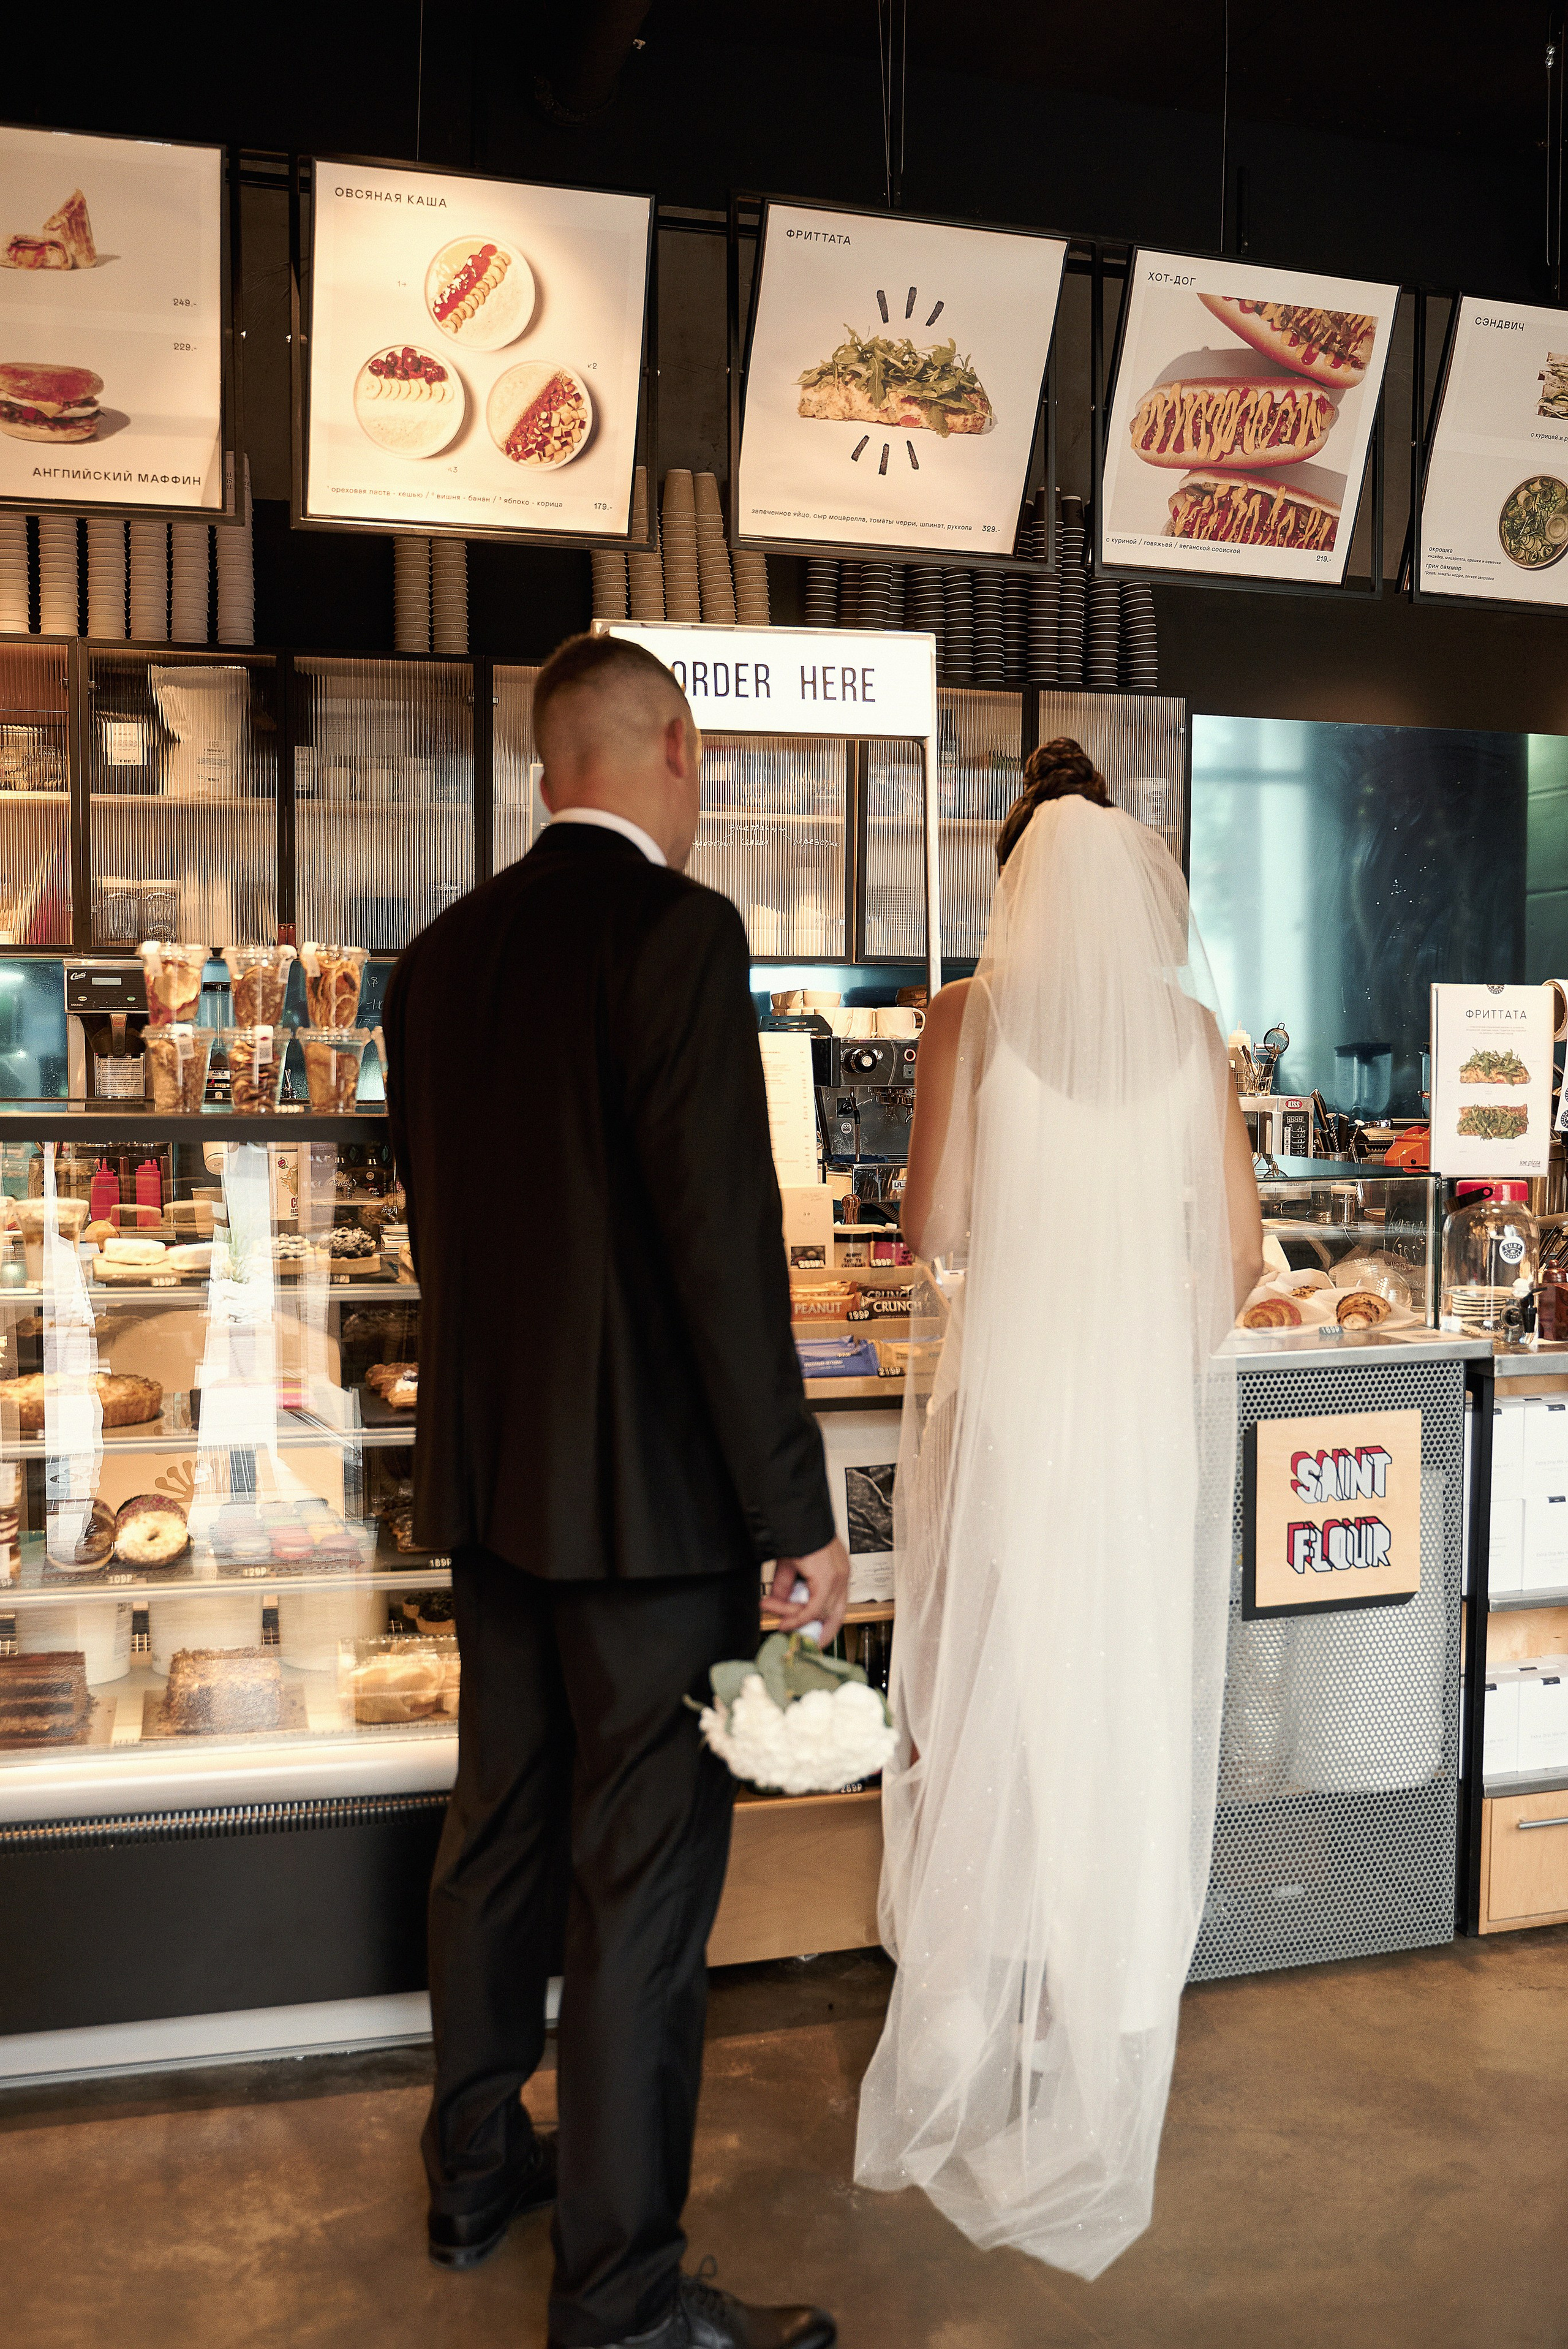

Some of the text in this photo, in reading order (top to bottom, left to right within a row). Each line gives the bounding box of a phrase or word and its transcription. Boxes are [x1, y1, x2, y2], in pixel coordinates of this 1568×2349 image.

[334, 187, 447, 208] ОВСЯНАЯ КАША
[786, 229, 851, 245] ФРИТТАТА
[1147, 271, 1196, 286] ХОТ-ДОГ
[1475, 317, 1525, 331] СЭНДВИЧ
[32, 467, 202, 486] АНГЛИЙСКИЙ МАФФИН
[829, 515, 867, 523] моцарелла,
[1144, 540, 1173, 548] говяжьей
[672, 660, 876, 703] ORDER HERE
[1465, 1009, 1528, 1020] ФРИТТАТА
[794, 1302, 842, 1314] PEANUT
[873, 1300, 922, 1313] CRUNCH
[1290, 1445, 1392, 1504] SAINT
[1286, 1515, 1392, 1575] FLOUR
